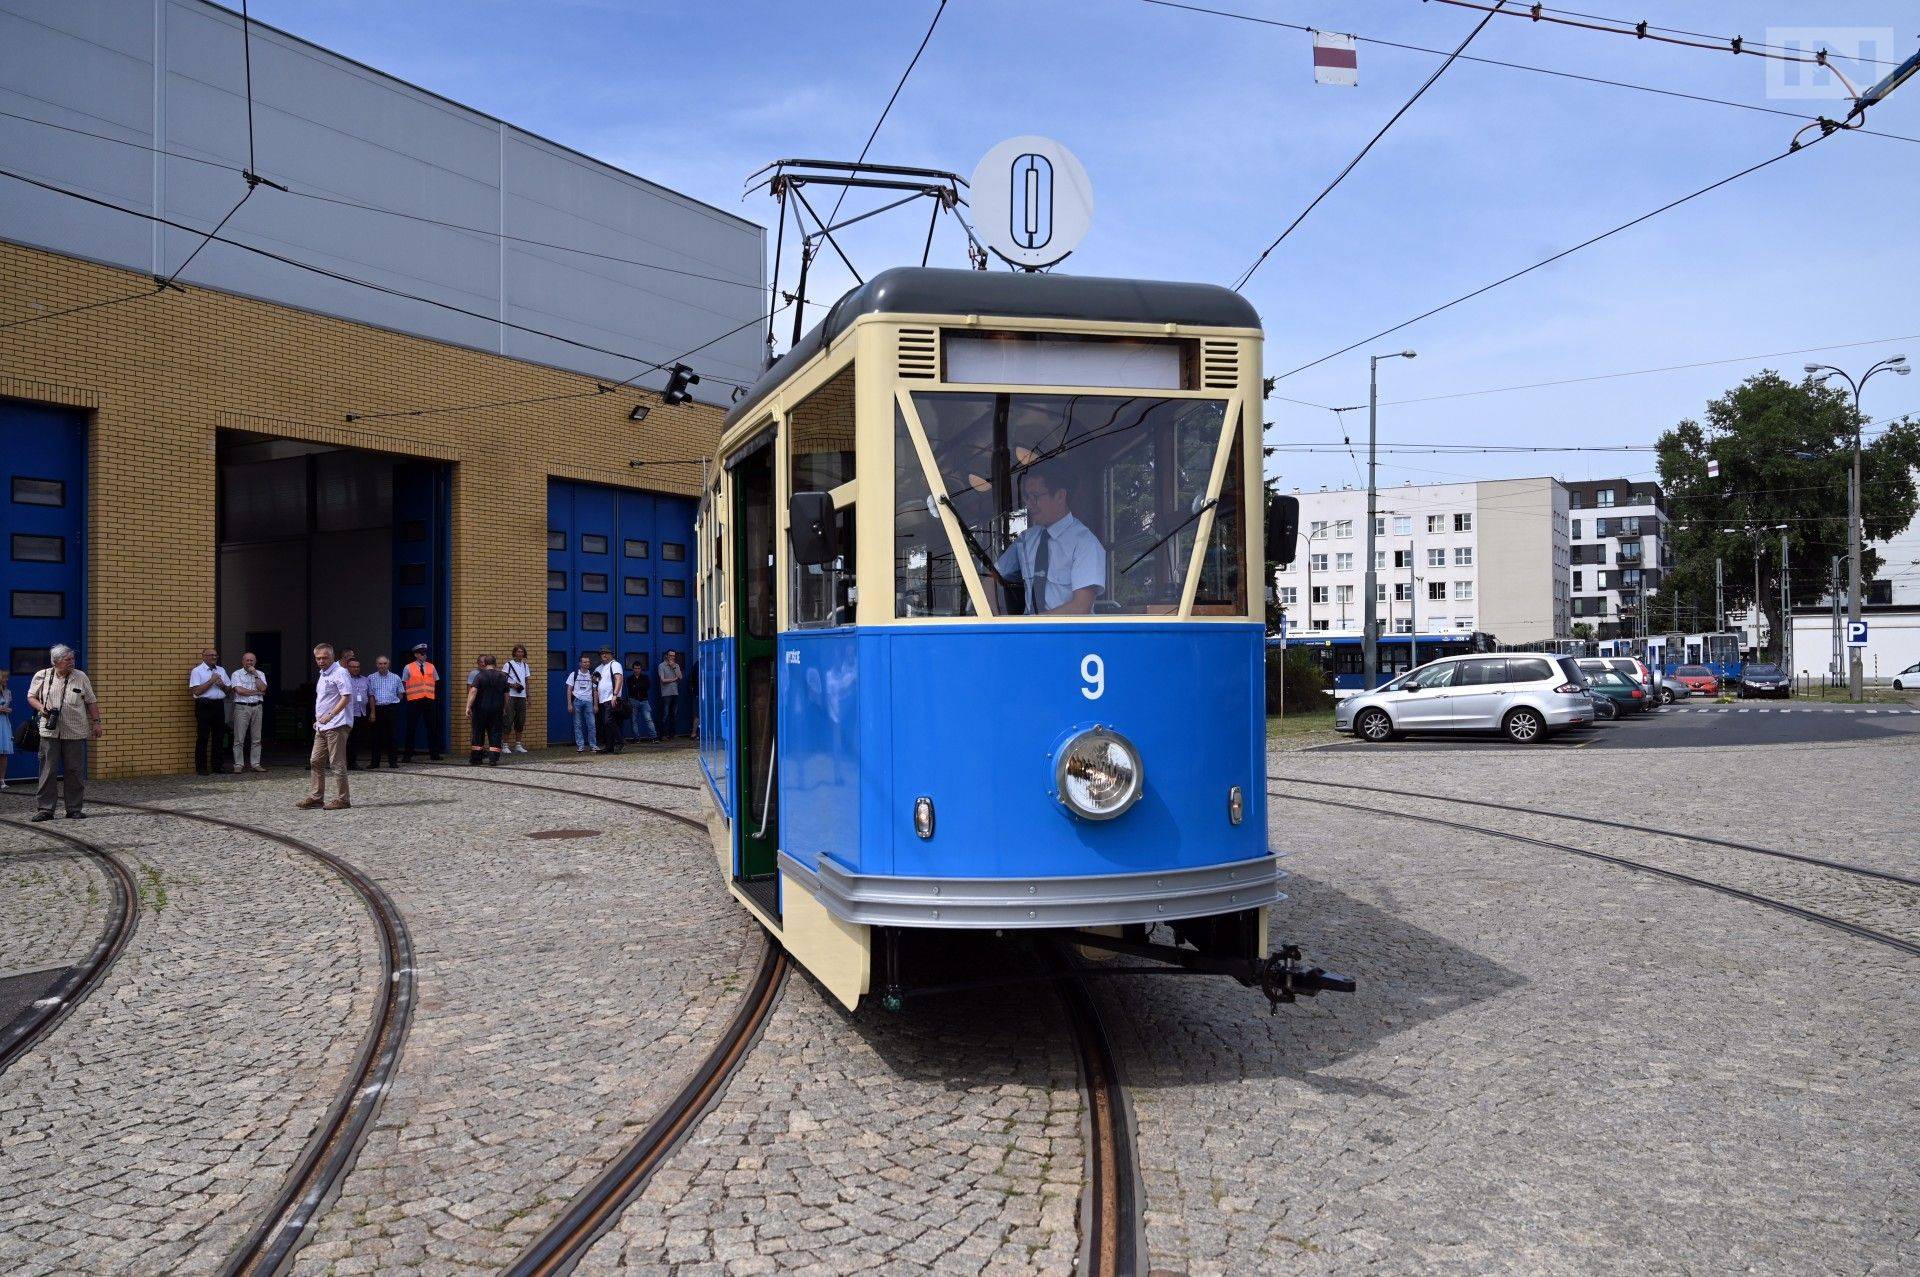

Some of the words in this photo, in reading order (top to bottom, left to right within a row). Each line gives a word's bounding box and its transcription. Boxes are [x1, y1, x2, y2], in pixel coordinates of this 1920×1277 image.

[1010, 153, 1054, 249] 0
[1848, 623, 1866, 642] P
[1081, 653, 1104, 700] 9
